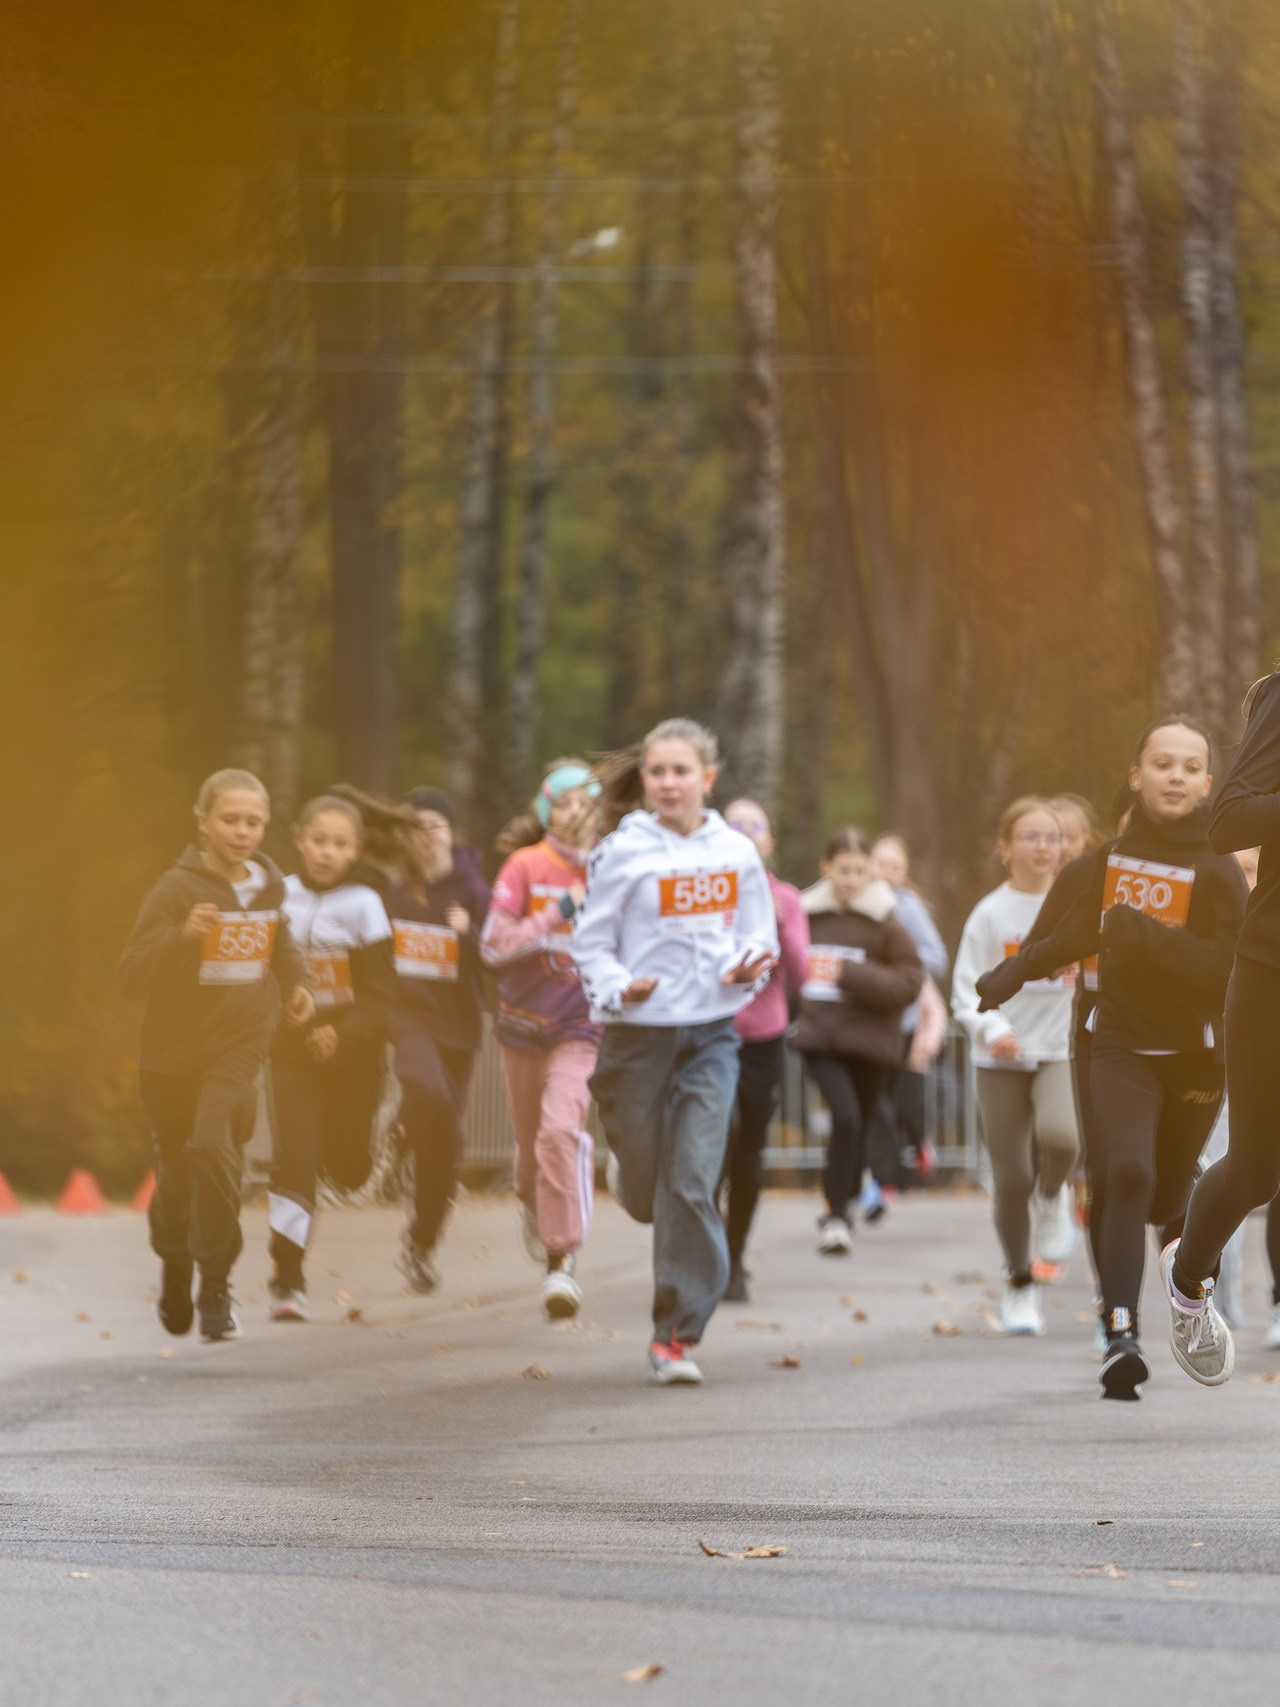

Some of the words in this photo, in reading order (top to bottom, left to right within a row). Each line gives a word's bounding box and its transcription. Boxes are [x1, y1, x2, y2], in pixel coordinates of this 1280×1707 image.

[674, 874, 730, 912] 580
[1113, 874, 1173, 911] 530
[218, 920, 270, 957] 558
